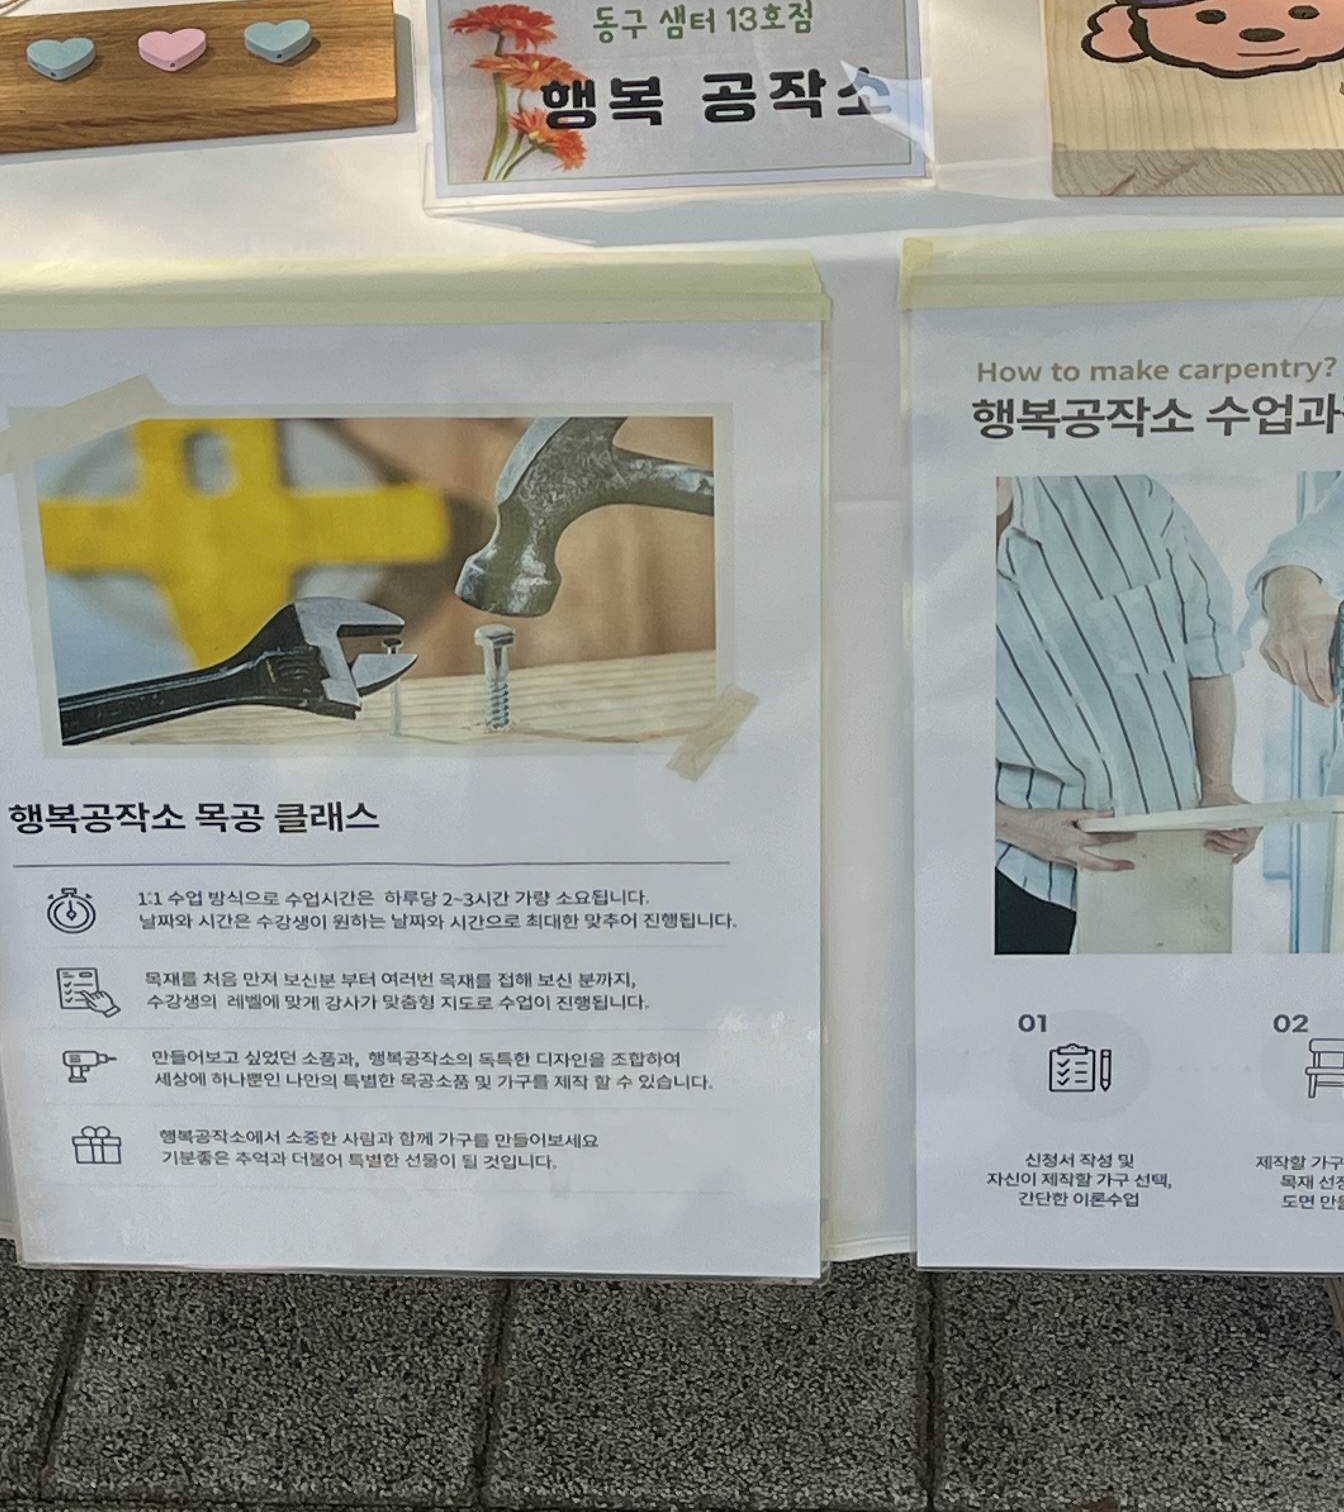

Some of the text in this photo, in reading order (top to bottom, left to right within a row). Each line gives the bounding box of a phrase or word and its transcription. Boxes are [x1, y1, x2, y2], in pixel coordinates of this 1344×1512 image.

[593, 0, 814, 43] 동구 샘터 13호점
[540, 75, 663, 131] 행복
[977, 356, 1338, 384] How to make carpentry?
[971, 396, 1194, 439] 행복공작소
[8, 800, 380, 834] 행복공작소 목공 클래스
[167, 889, 203, 907] 수업
[207, 889, 280, 907] 방식으로
[285, 889, 375, 908] 수업시간은
[384, 889, 438, 907] 하루당
[514, 889, 552, 907] 가량
[138, 912, 193, 930] 날짜와
[198, 912, 251, 930] 시간은
[256, 913, 327, 931] 수강생이
[332, 912, 386, 930] 원하는
[390, 912, 445, 930] 날짜와
[449, 913, 521, 931] 시간으로
[526, 912, 580, 930] 최대한
[583, 911, 638, 929] 맞추어
[146, 992, 217, 1010] 수강생의
[284, 993, 321, 1011] 맞게
[324, 994, 377, 1011] 강사가
[382, 993, 435, 1010] 맞춤형
[440, 995, 494, 1011] 지도로
[498, 994, 551, 1010] 수업이
[1018, 1014, 1048, 1033] 01
[1272, 1013, 1310, 1034] 02
[1024, 1151, 1134, 1169] 신청서 작성 및
[1255, 1154, 1307, 1171] 제작할
[986, 1170, 1037, 1187] 자신이
[1041, 1170, 1092, 1188] 제작할
[1096, 1171, 1130, 1188] 가구
[1018, 1190, 1140, 1208] 간단한 이론수업
